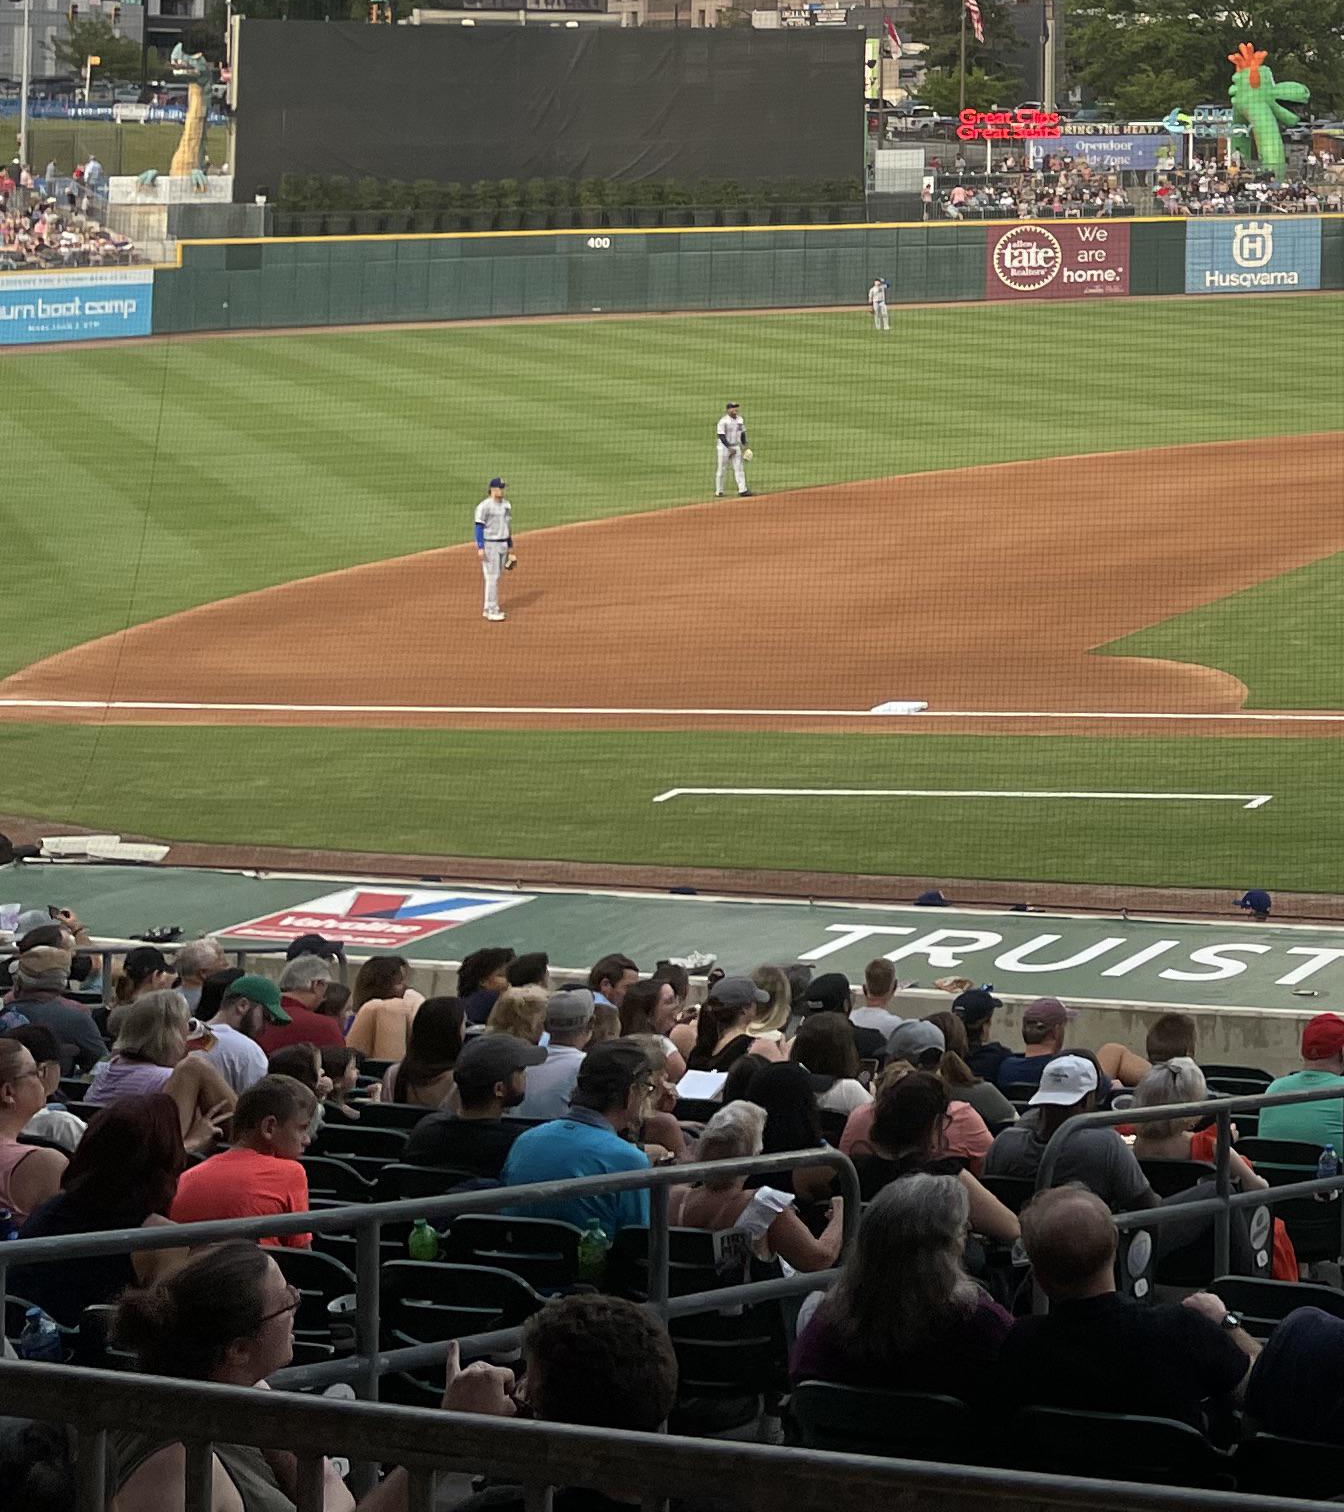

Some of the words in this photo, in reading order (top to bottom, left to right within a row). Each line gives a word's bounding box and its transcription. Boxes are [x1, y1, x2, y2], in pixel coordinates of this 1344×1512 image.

[959, 108, 1013, 125] Great
[1016, 108, 1060, 126] Clips
[956, 124, 1012, 140] Great
[1099, 126, 1120, 135] THE
[1075, 140, 1134, 152] Opendoor
[1077, 226, 1108, 242] We
[587, 237, 610, 248] 400
[1001, 242, 1055, 268] tate
[1077, 249, 1106, 263] are
[1205, 270, 1298, 287] Husqvarna
[38, 296, 80, 319] boot
[85, 299, 137, 319] camp
